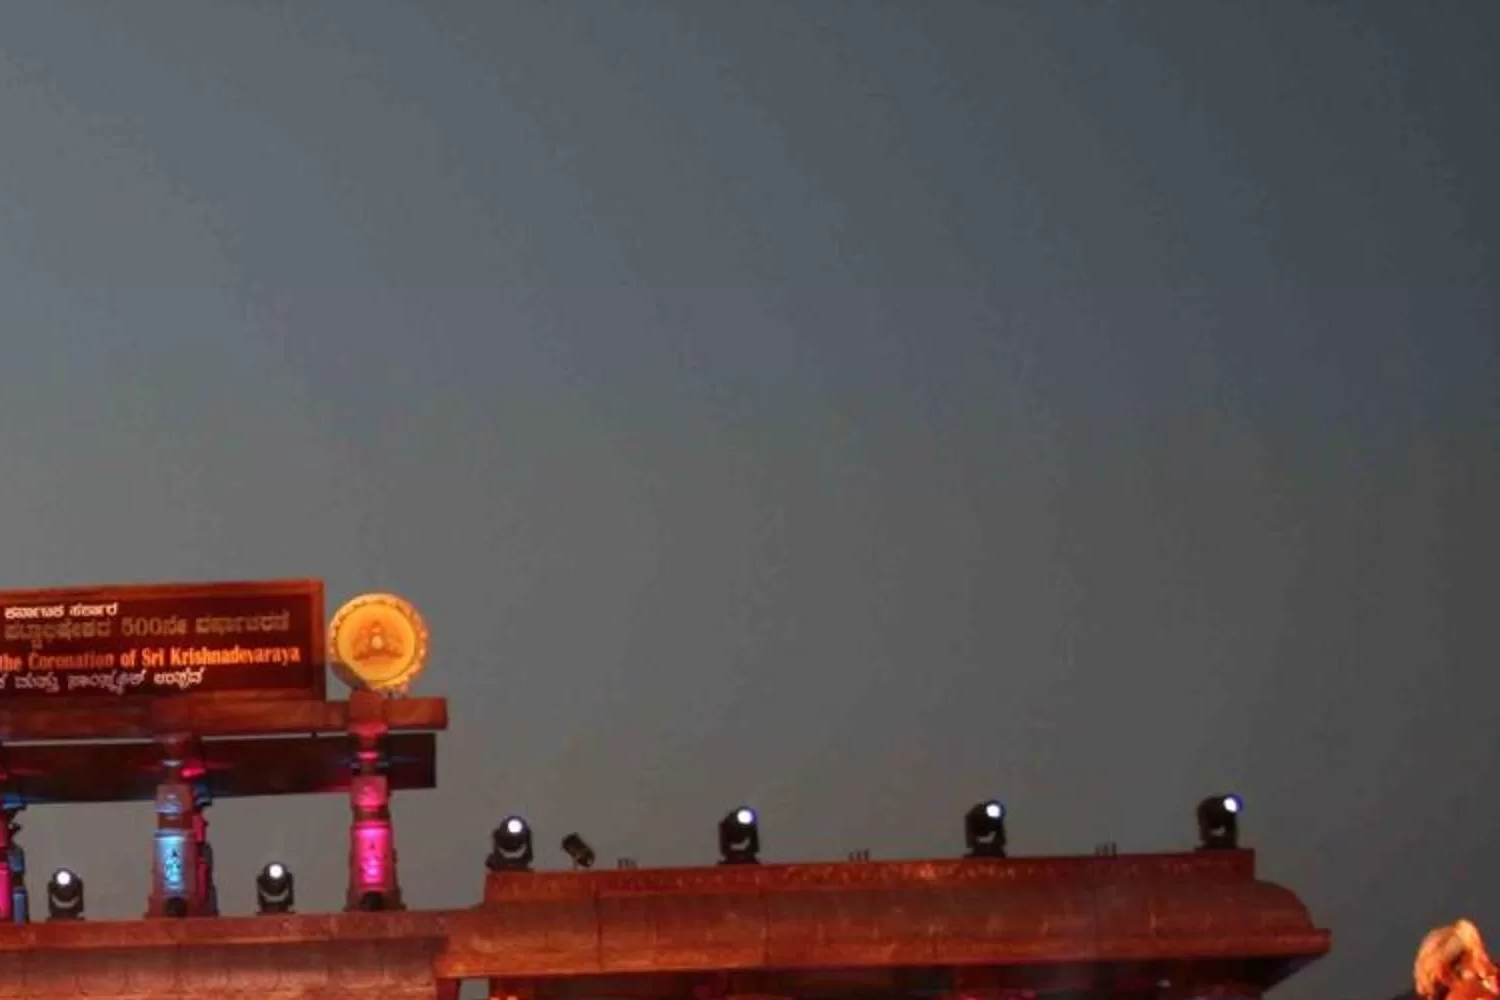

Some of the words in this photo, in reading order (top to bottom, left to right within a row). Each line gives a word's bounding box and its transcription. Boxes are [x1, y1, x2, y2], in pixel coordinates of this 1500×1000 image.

[28, 651, 115, 670] Coronation
[119, 649, 137, 669] of
[141, 647, 165, 668] Sri
[170, 644, 301, 667] Krishnadevaraya
